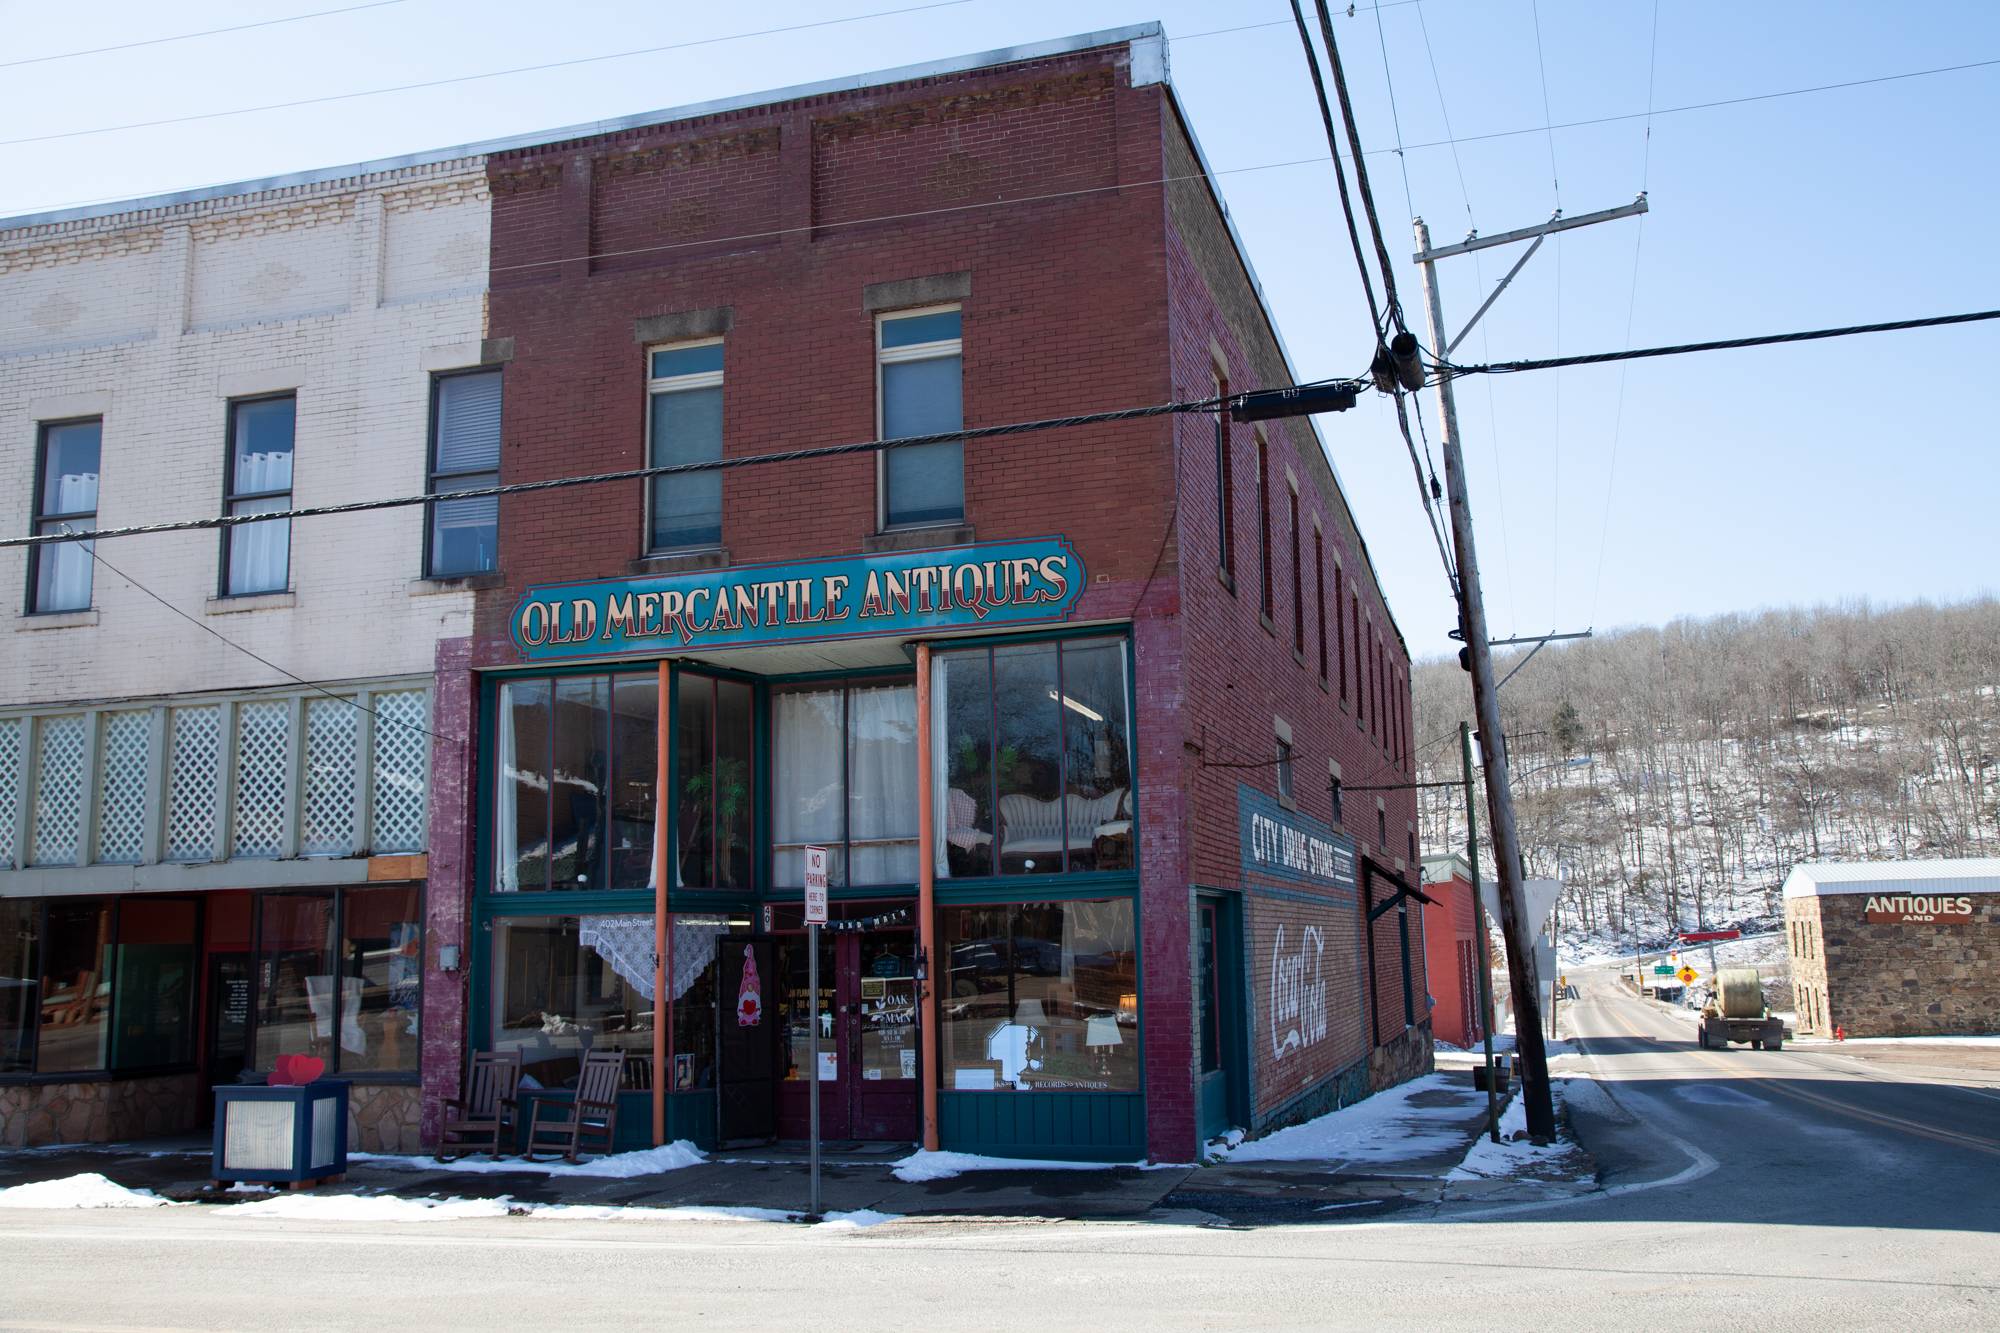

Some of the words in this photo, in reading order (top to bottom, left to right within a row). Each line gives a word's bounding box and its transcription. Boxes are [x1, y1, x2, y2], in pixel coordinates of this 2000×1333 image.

[520, 598, 598, 646] OLD
[602, 575, 851, 645] MERCANTILE
[859, 555, 1069, 620] ANTIQUES
[1252, 812, 1278, 863] CITY
[1282, 824, 1308, 871] DRUG
[1309, 836, 1335, 879] STORE
[811, 854, 821, 868] NO
[807, 872, 826, 888] PARKING
[808, 892, 818, 901] HERE
[819, 892, 825, 902] TO
[809, 905, 824, 915] CORNER
[1864, 896, 1973, 915] ANTIQUES
[600, 919, 615, 928] 402
[615, 918, 632, 928] Main
[632, 917, 654, 927] Street
[838, 921, 862, 931] AND
[873, 908, 907, 926] MAIN
[887, 995, 908, 1005] OAK
[885, 1013, 911, 1023] MAIN
